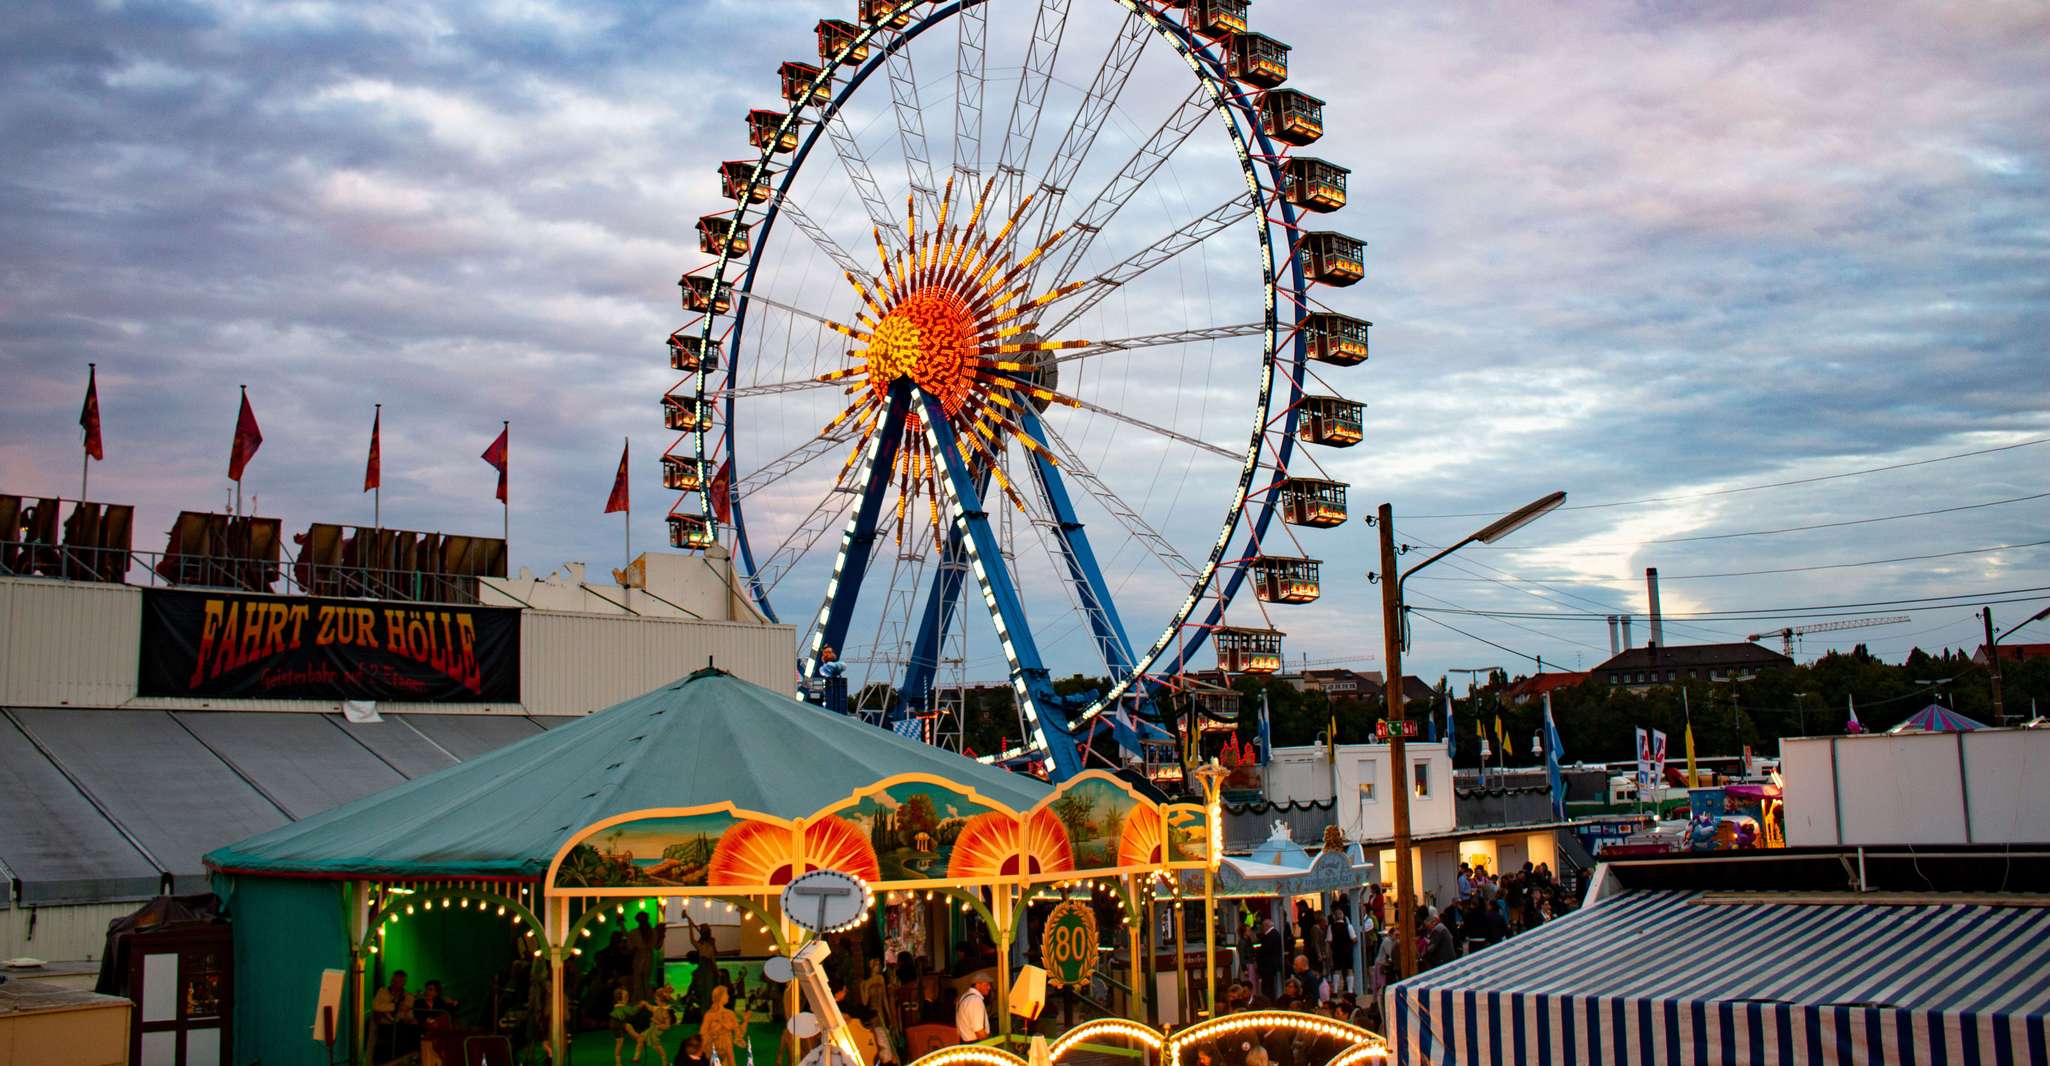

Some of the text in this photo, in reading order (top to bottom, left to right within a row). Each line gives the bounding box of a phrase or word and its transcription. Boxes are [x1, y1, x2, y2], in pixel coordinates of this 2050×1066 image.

[188, 599, 481, 695] FAHRT ZUR HÖLLE
[1056, 926, 1086, 961] 80
